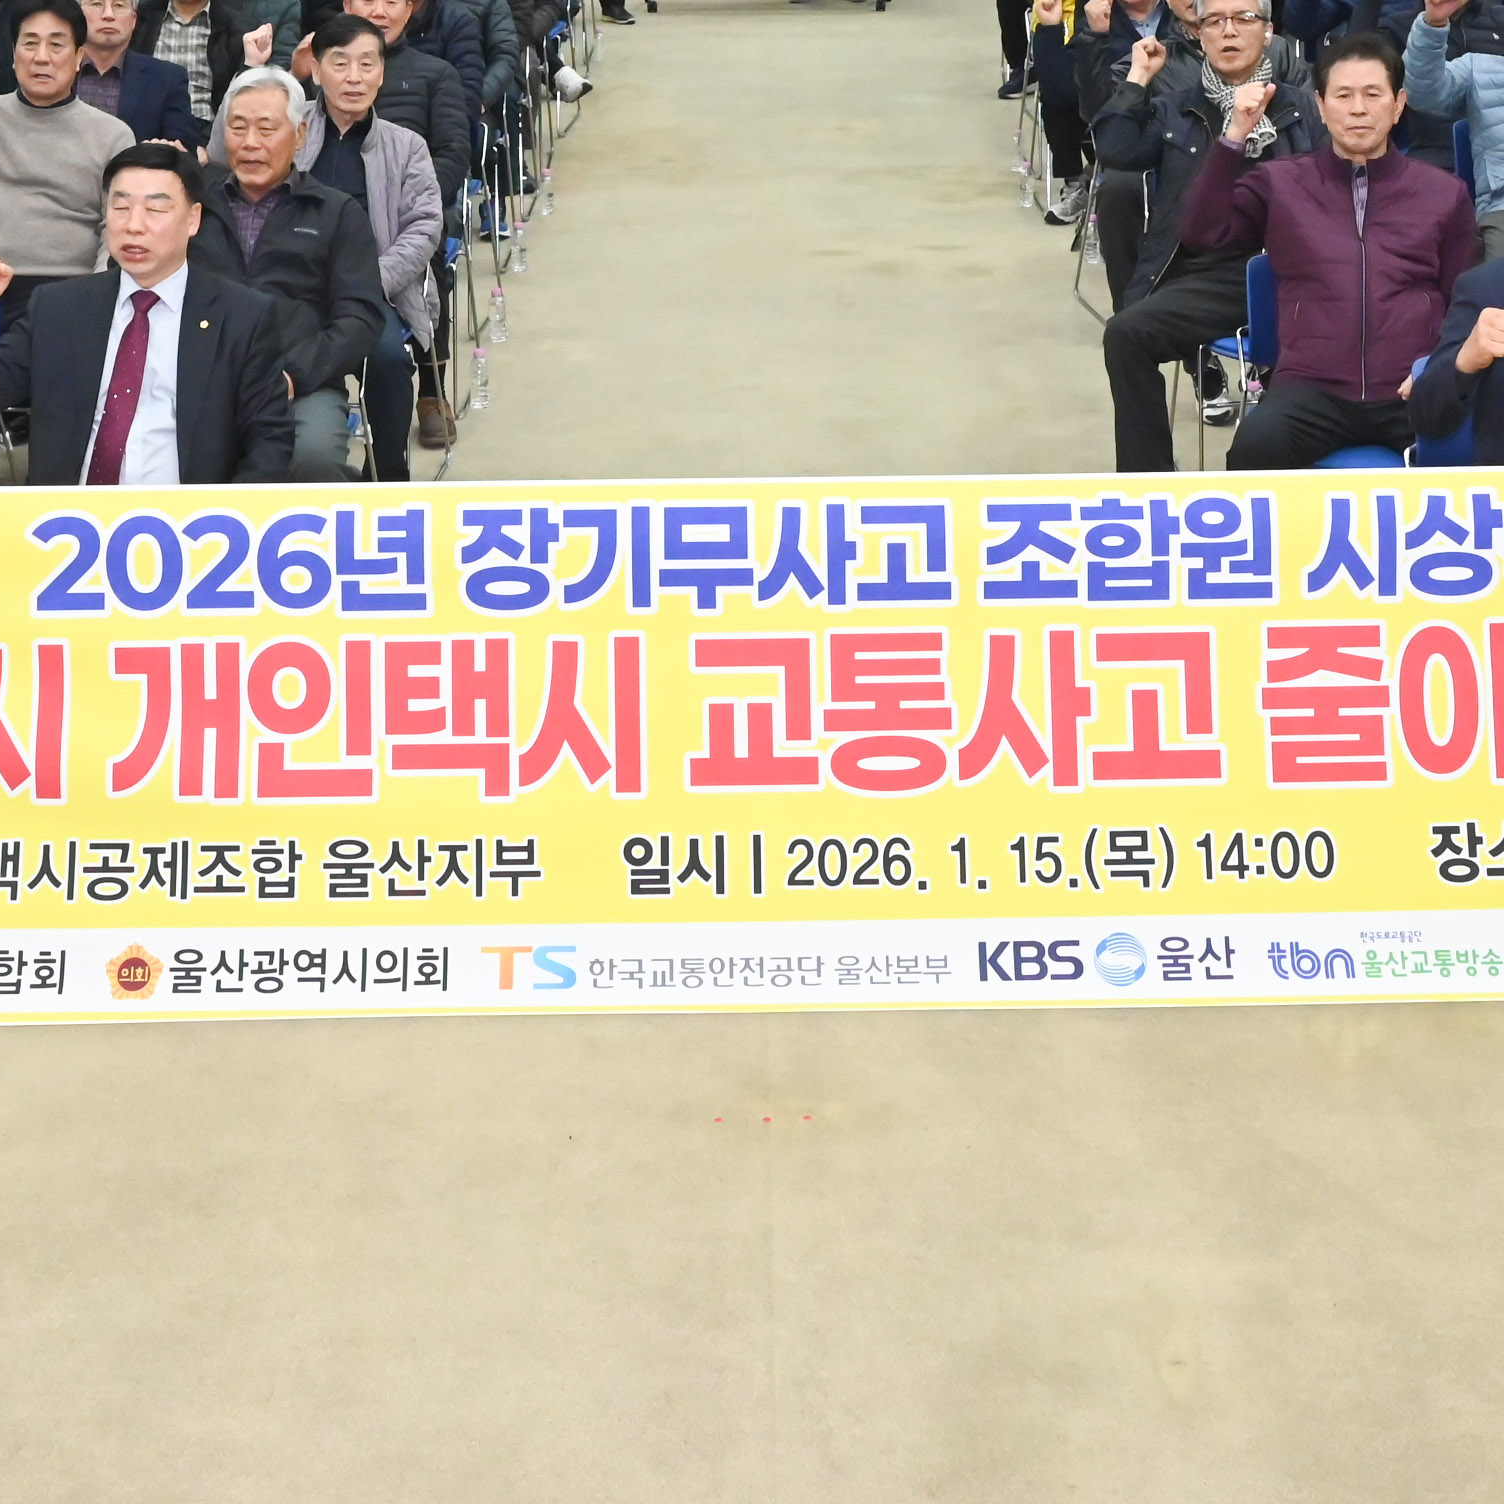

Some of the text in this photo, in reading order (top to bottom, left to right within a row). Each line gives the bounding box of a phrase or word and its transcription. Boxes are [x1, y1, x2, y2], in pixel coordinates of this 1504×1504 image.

[32, 509, 427, 611] 2026년
[462, 504, 952, 610] 장기무사고
[984, 497, 1273, 601] 조합원
[114, 637, 640, 798] 개인택시
[691, 631, 1221, 791] 교통사고
[323, 839, 540, 897] 울산지부
[624, 836, 724, 894] 일시
[788, 838, 926, 890] 2026.
[951, 838, 986, 889] 1.
[1011, 827, 1173, 889] 15.(목)
[1197, 831, 1334, 879] 14:00
[1157, 936, 1235, 980] 울산
[1360, 930, 1422, 943] 한국도로교통공단
[119, 965, 149, 982] 의회
[170, 947, 448, 993] 울산광역시의회
[480, 946, 576, 990] TS
[589, 955, 952, 990] 한국교통안전공단 울산본부
[978, 940, 1084, 981] KBS
[1267, 941, 1356, 980] tbn
[1361, 948, 1504, 979] 울산교통방송
